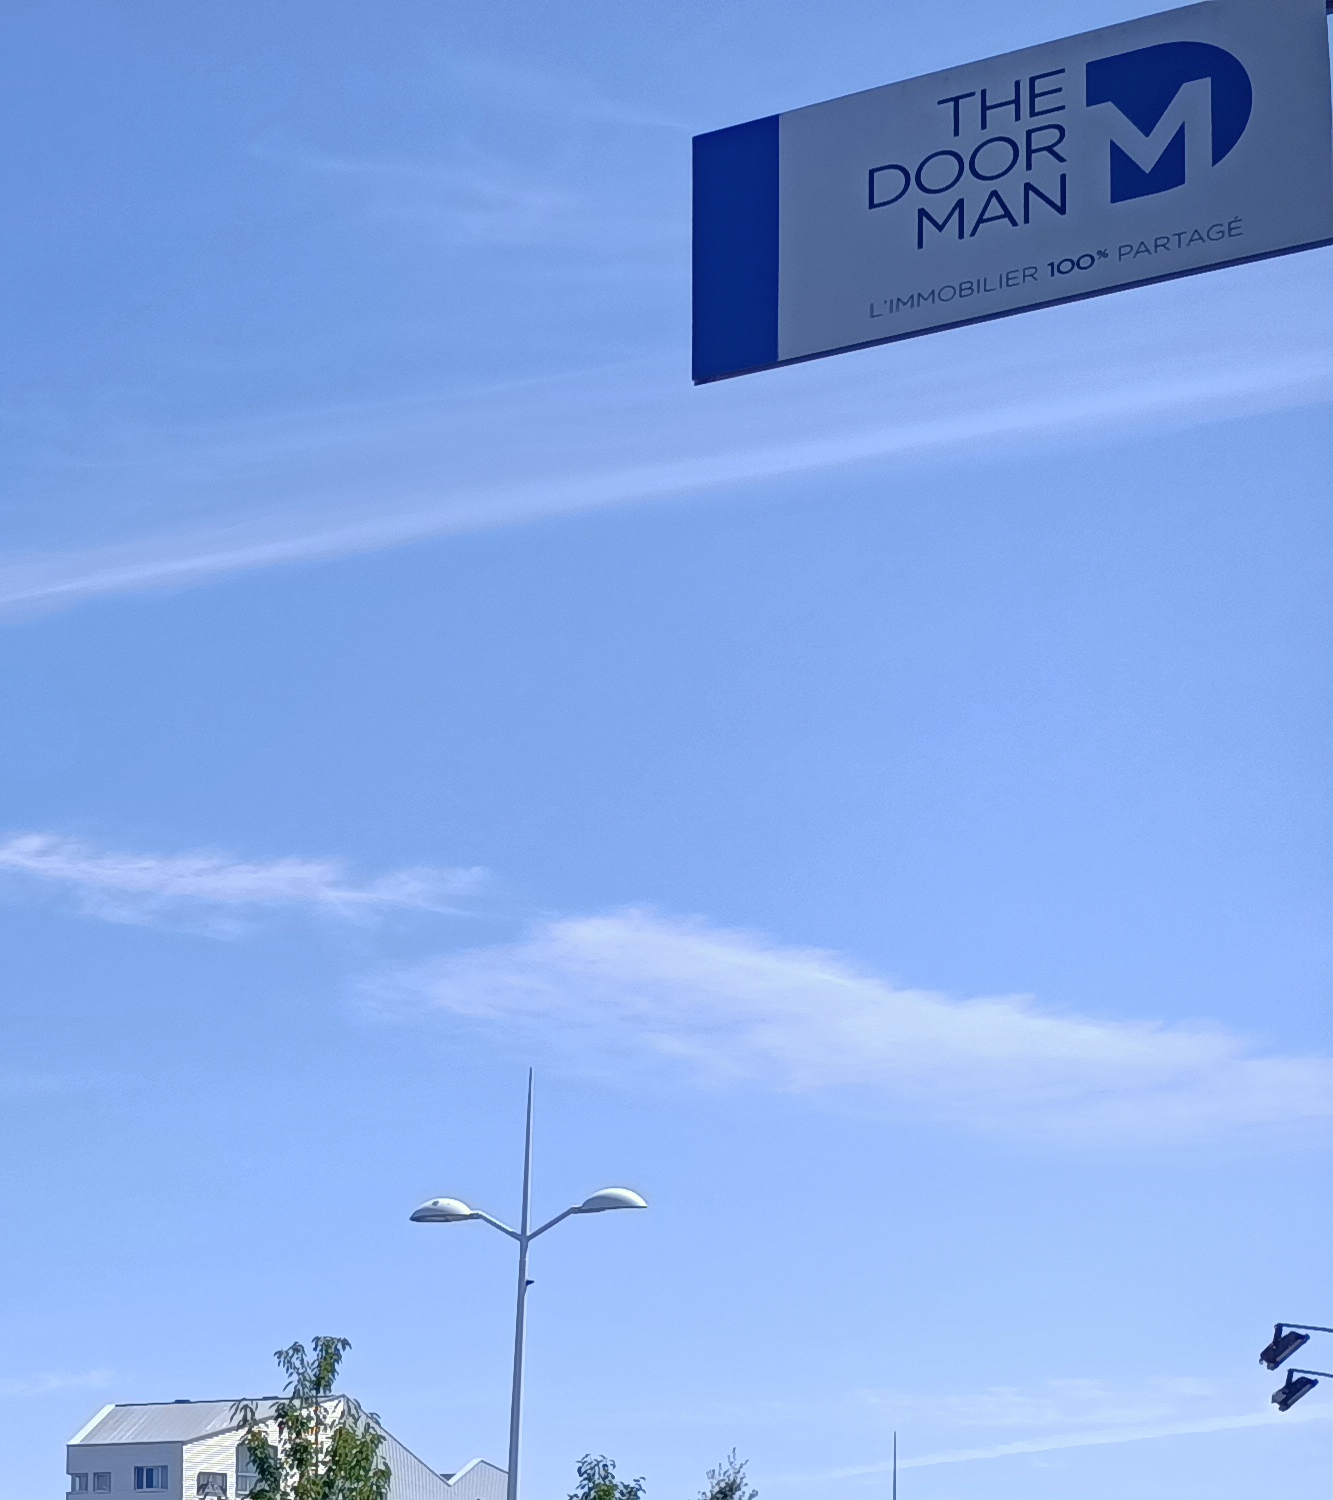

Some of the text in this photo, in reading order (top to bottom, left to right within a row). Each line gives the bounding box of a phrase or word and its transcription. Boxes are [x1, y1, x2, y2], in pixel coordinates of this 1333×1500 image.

[936, 67, 1066, 138] THE
[867, 123, 1068, 211] DOOR
[916, 172, 1067, 251] MAN
[868, 215, 1244, 319] L'IMMOBILIER 100% PARTAGÉ
